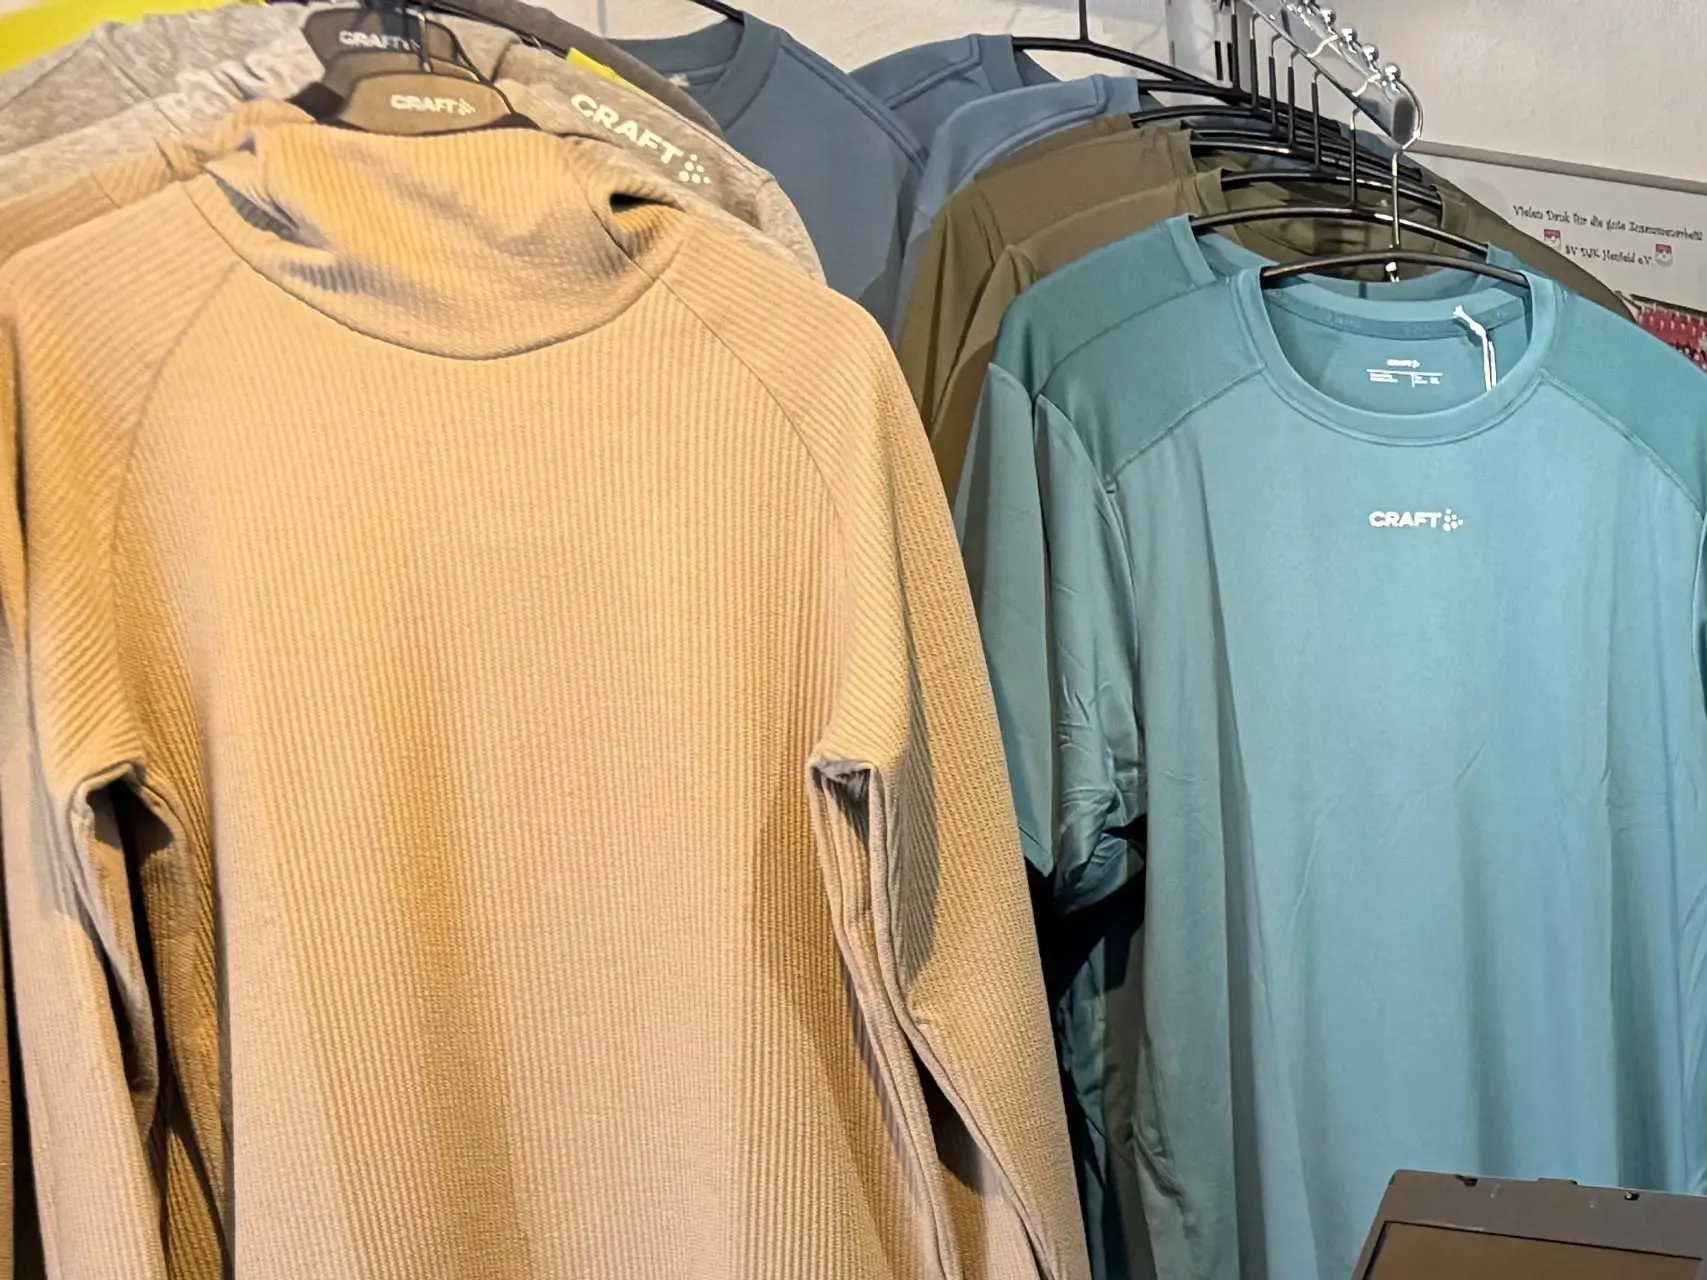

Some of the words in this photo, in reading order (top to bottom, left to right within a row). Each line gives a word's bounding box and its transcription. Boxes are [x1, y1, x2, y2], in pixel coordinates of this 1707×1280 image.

[391, 95, 458, 114] CRAFT
[570, 95, 684, 164] CRAFT
[1369, 510, 1441, 530] CRAFT
